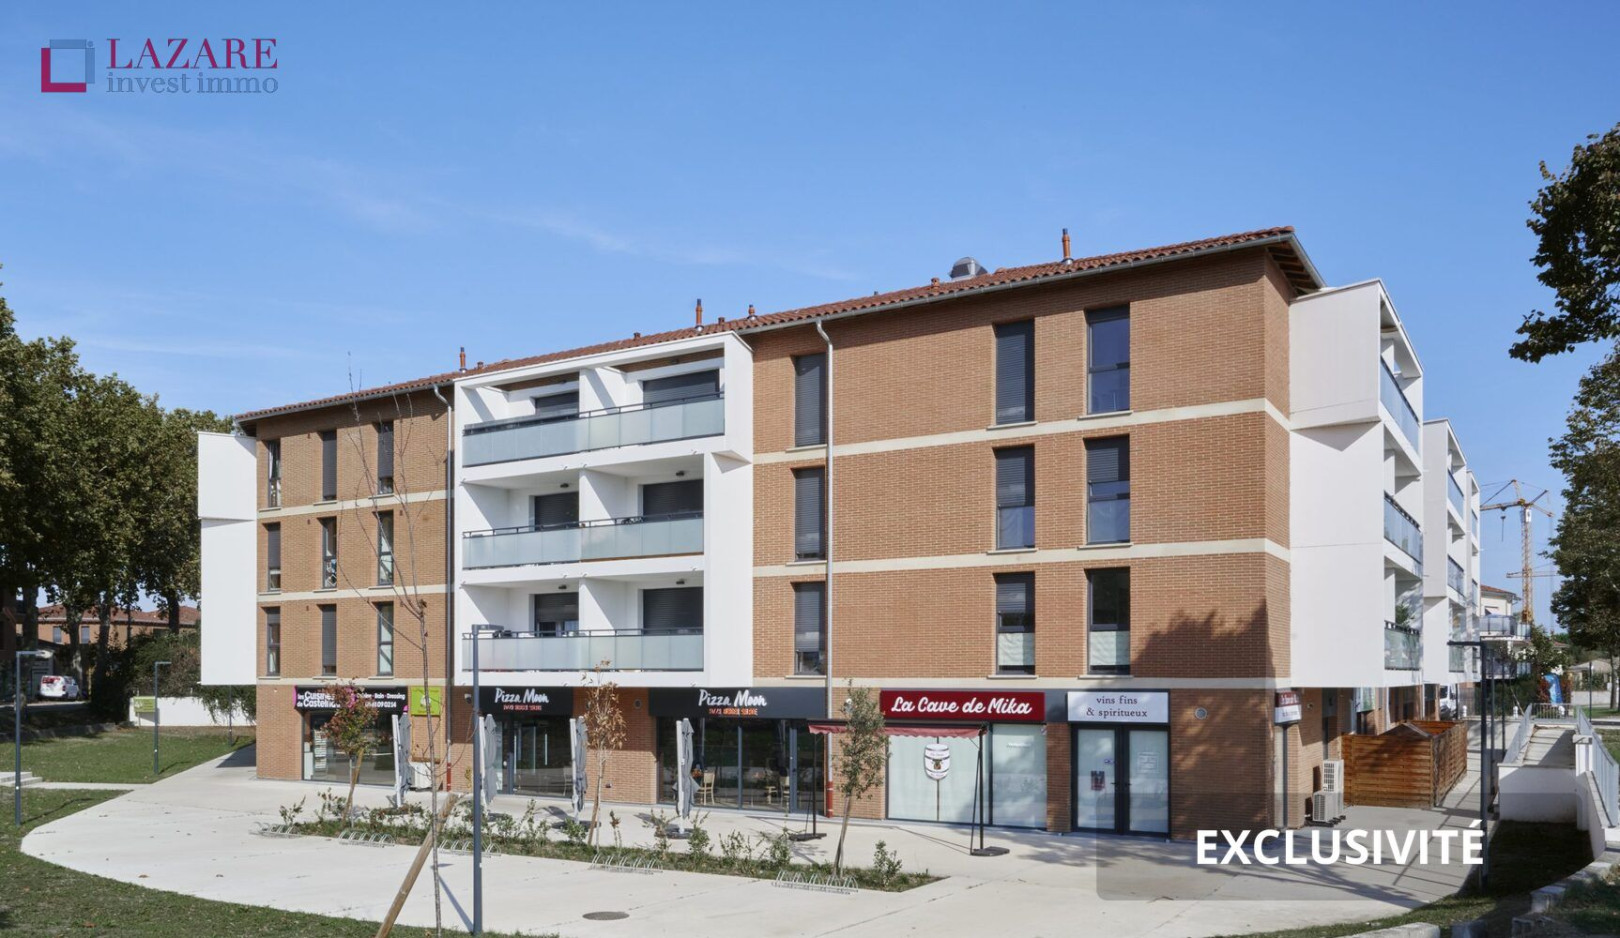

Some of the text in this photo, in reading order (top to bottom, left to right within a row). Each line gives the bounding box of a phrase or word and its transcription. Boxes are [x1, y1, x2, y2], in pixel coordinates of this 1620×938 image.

[494, 687, 549, 703] Pizza Moon
[698, 688, 768, 707] Pizza Moon
[1096, 695, 1138, 705] vins fins
[891, 696, 1033, 715] La Cave de Mika
[1086, 707, 1148, 719] & spiritueux
